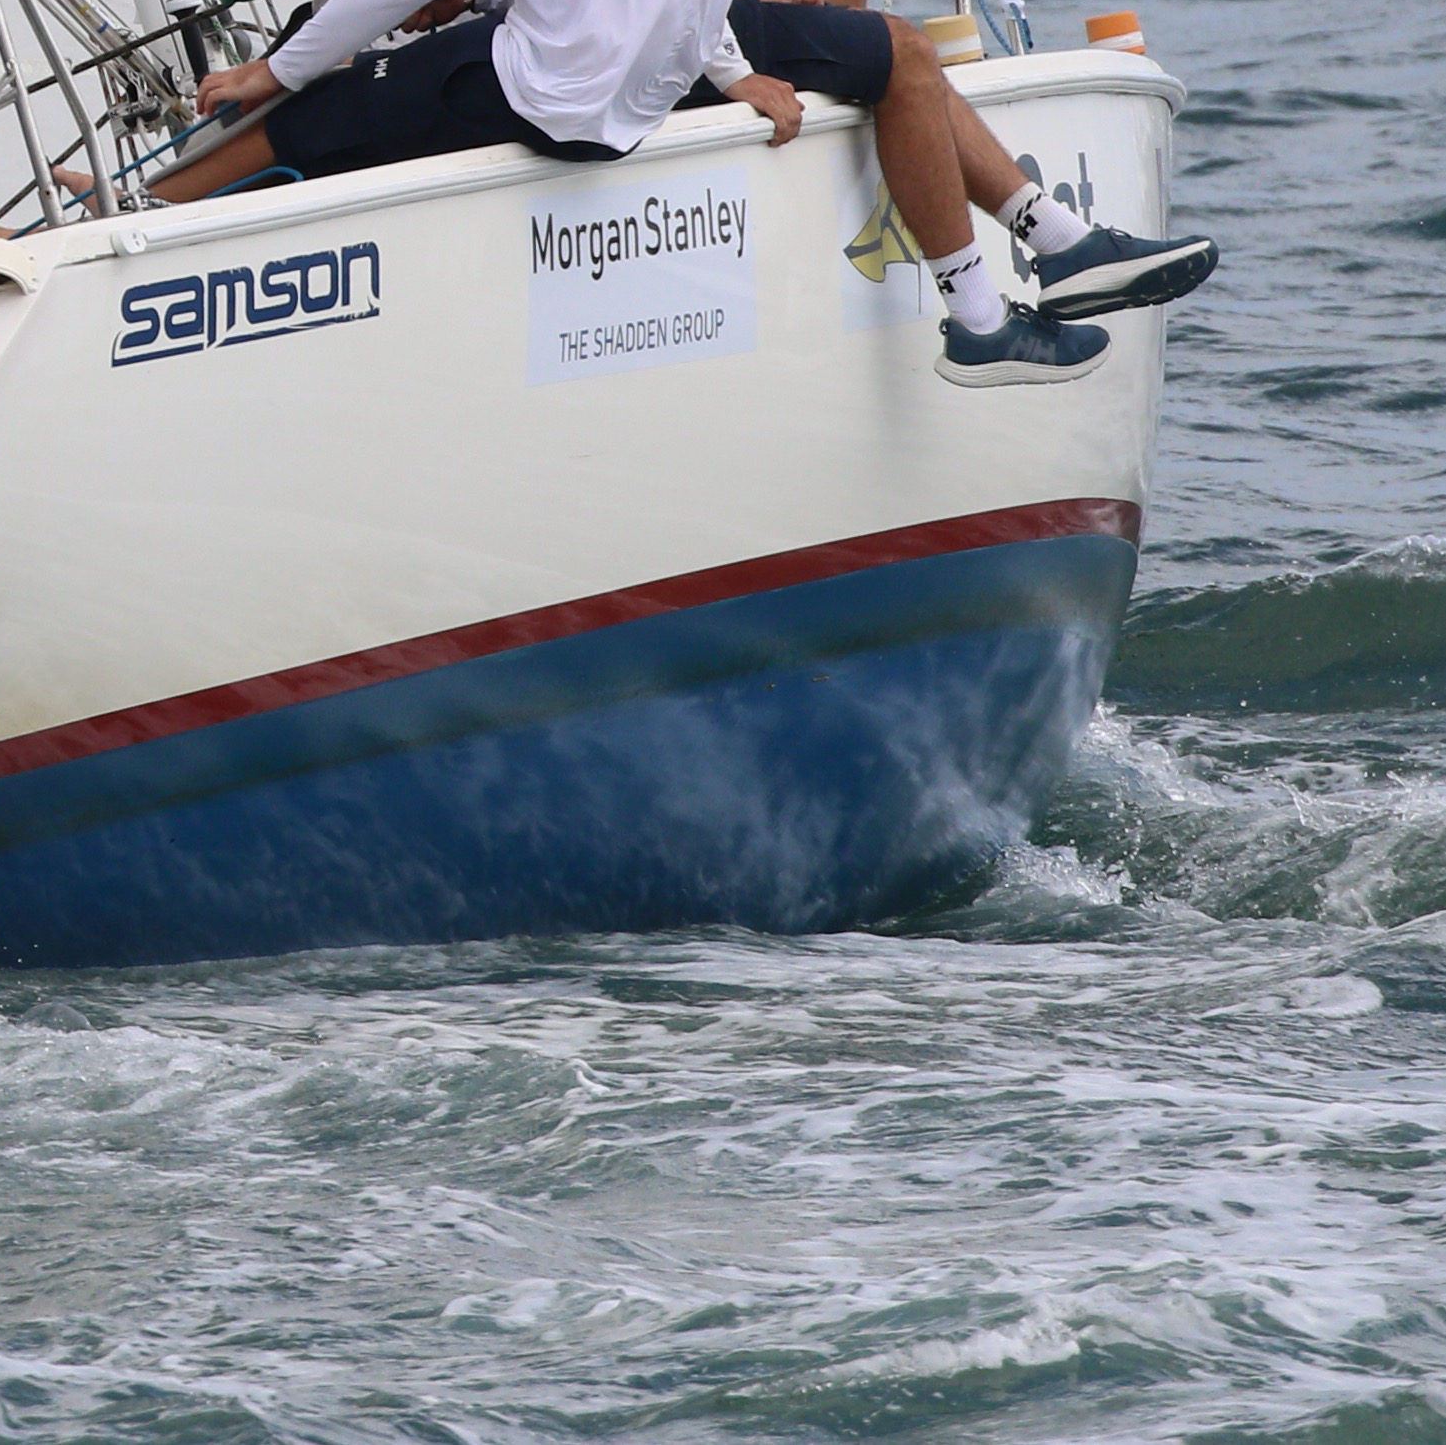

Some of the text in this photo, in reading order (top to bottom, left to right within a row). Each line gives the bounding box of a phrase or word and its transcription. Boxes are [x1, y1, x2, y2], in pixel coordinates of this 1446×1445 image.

[531, 188, 746, 281] Morgan Stanley
[119, 241, 380, 350] samson
[559, 308, 725, 363] THE SHADDEN GROUP
